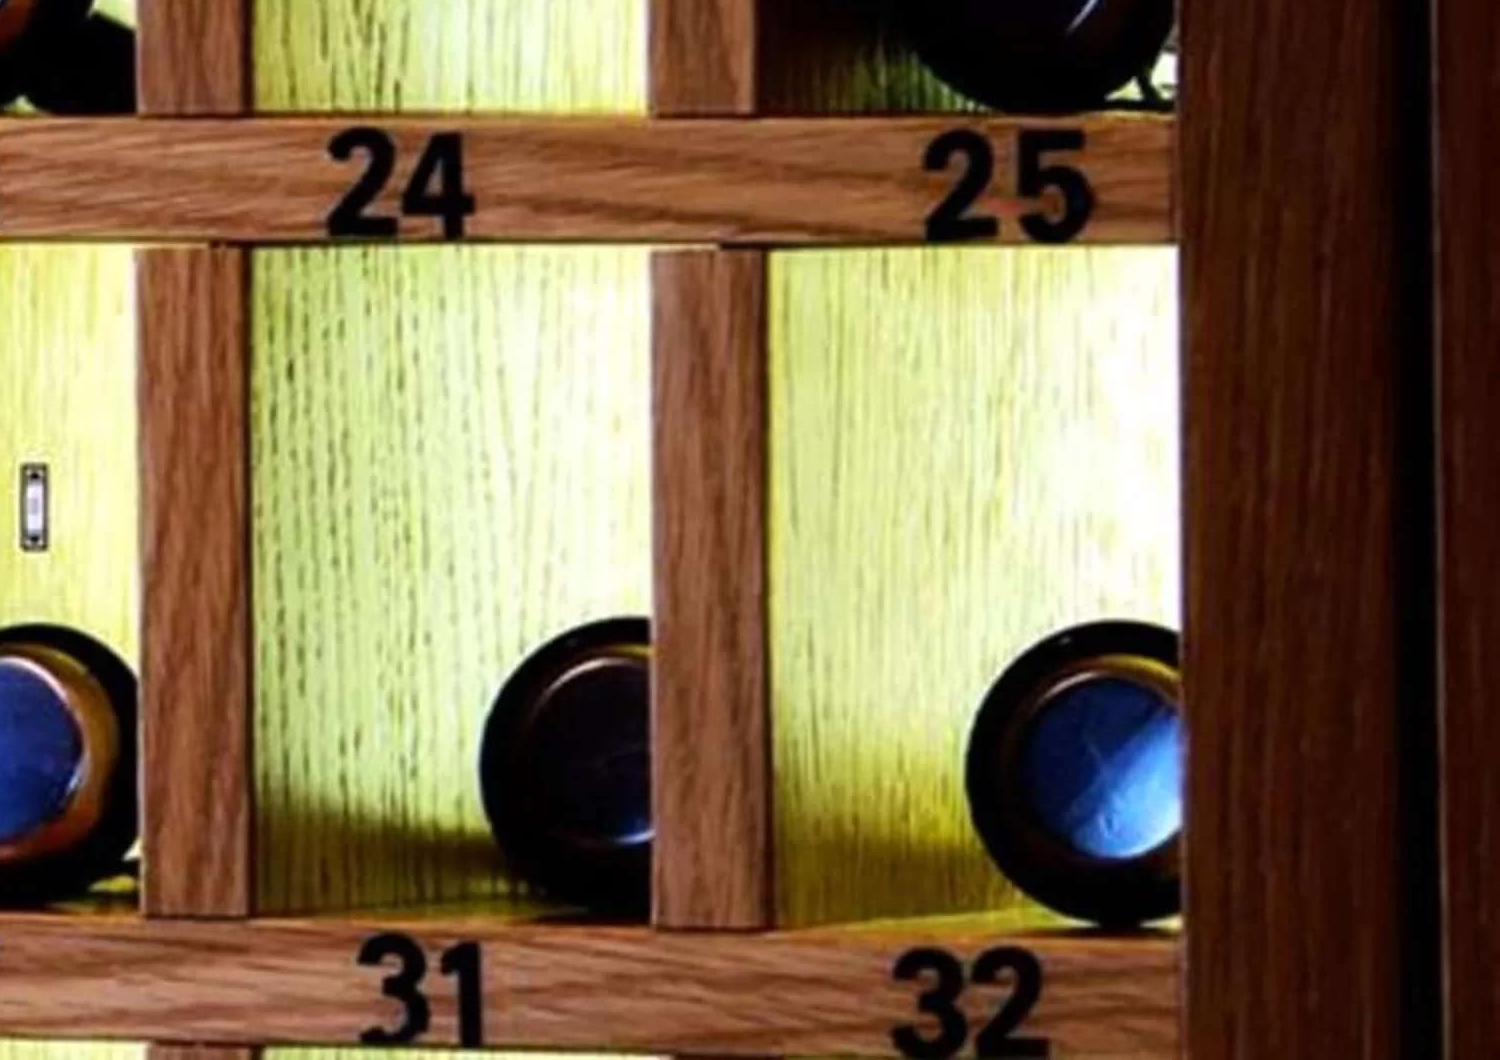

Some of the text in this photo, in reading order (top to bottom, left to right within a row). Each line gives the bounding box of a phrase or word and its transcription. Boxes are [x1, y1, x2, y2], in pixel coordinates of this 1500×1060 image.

[326, 126, 478, 240] 24
[924, 127, 1098, 240] 25
[357, 930, 485, 1047] 31
[891, 946, 1052, 1059] 32
